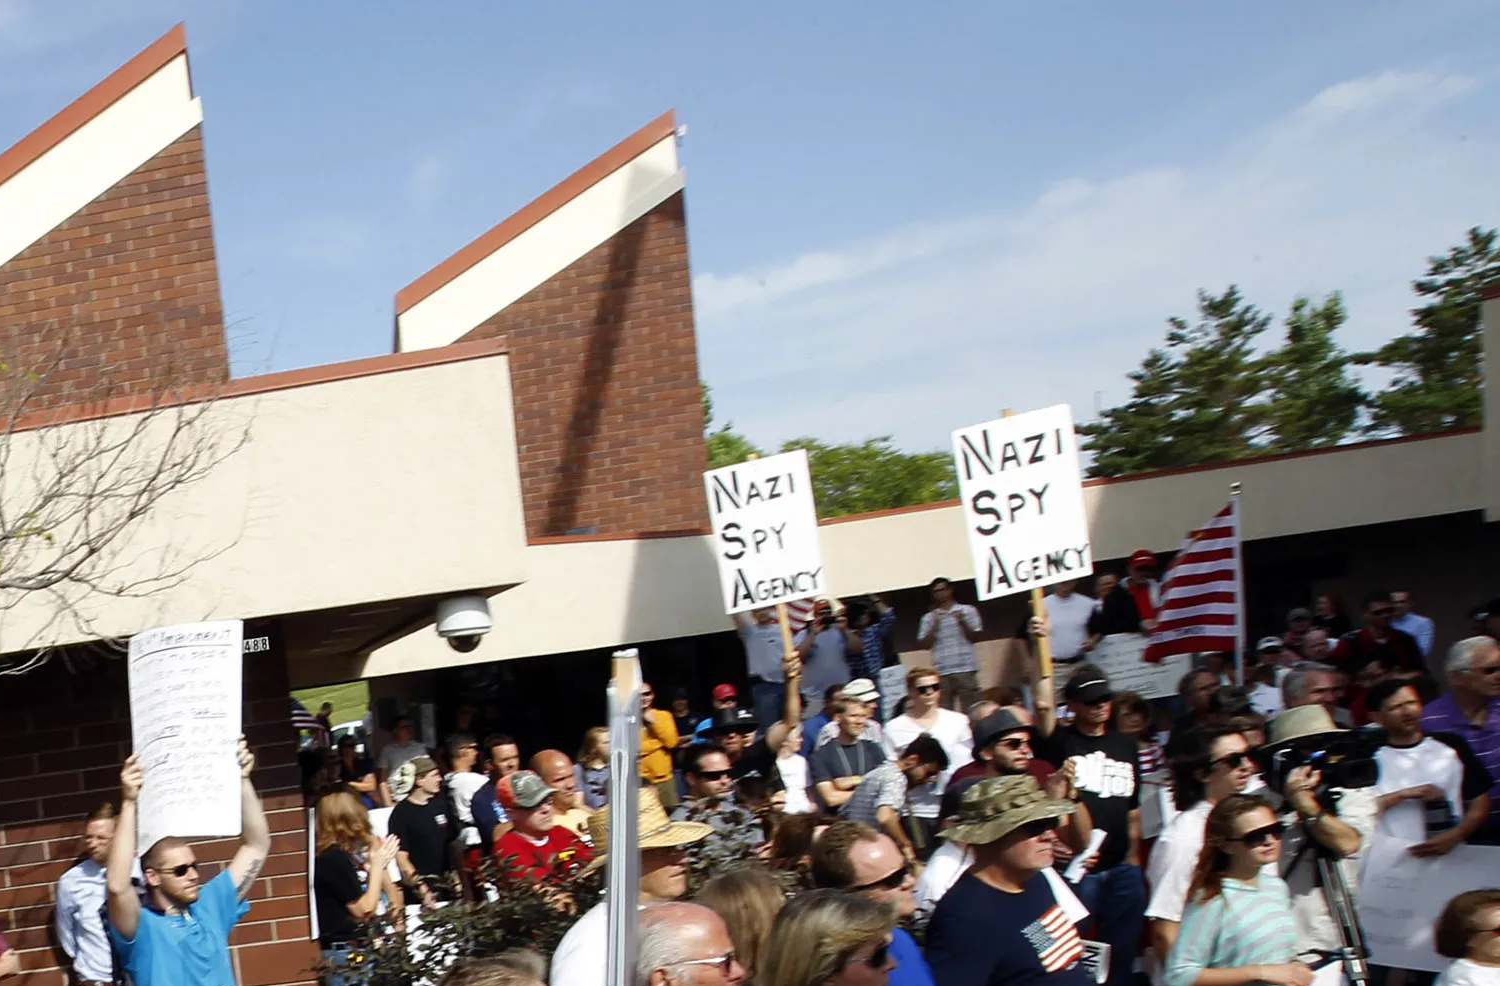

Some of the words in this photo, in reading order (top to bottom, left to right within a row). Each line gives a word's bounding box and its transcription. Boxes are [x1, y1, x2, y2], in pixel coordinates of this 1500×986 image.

[958, 427, 1063, 481] NAZI
[711, 470, 796, 514] NAZI
[972, 483, 1051, 536] SPY
[721, 522, 787, 560] SPY
[731, 566, 824, 608] AGENCY
[986, 543, 1090, 595] AGENCY
